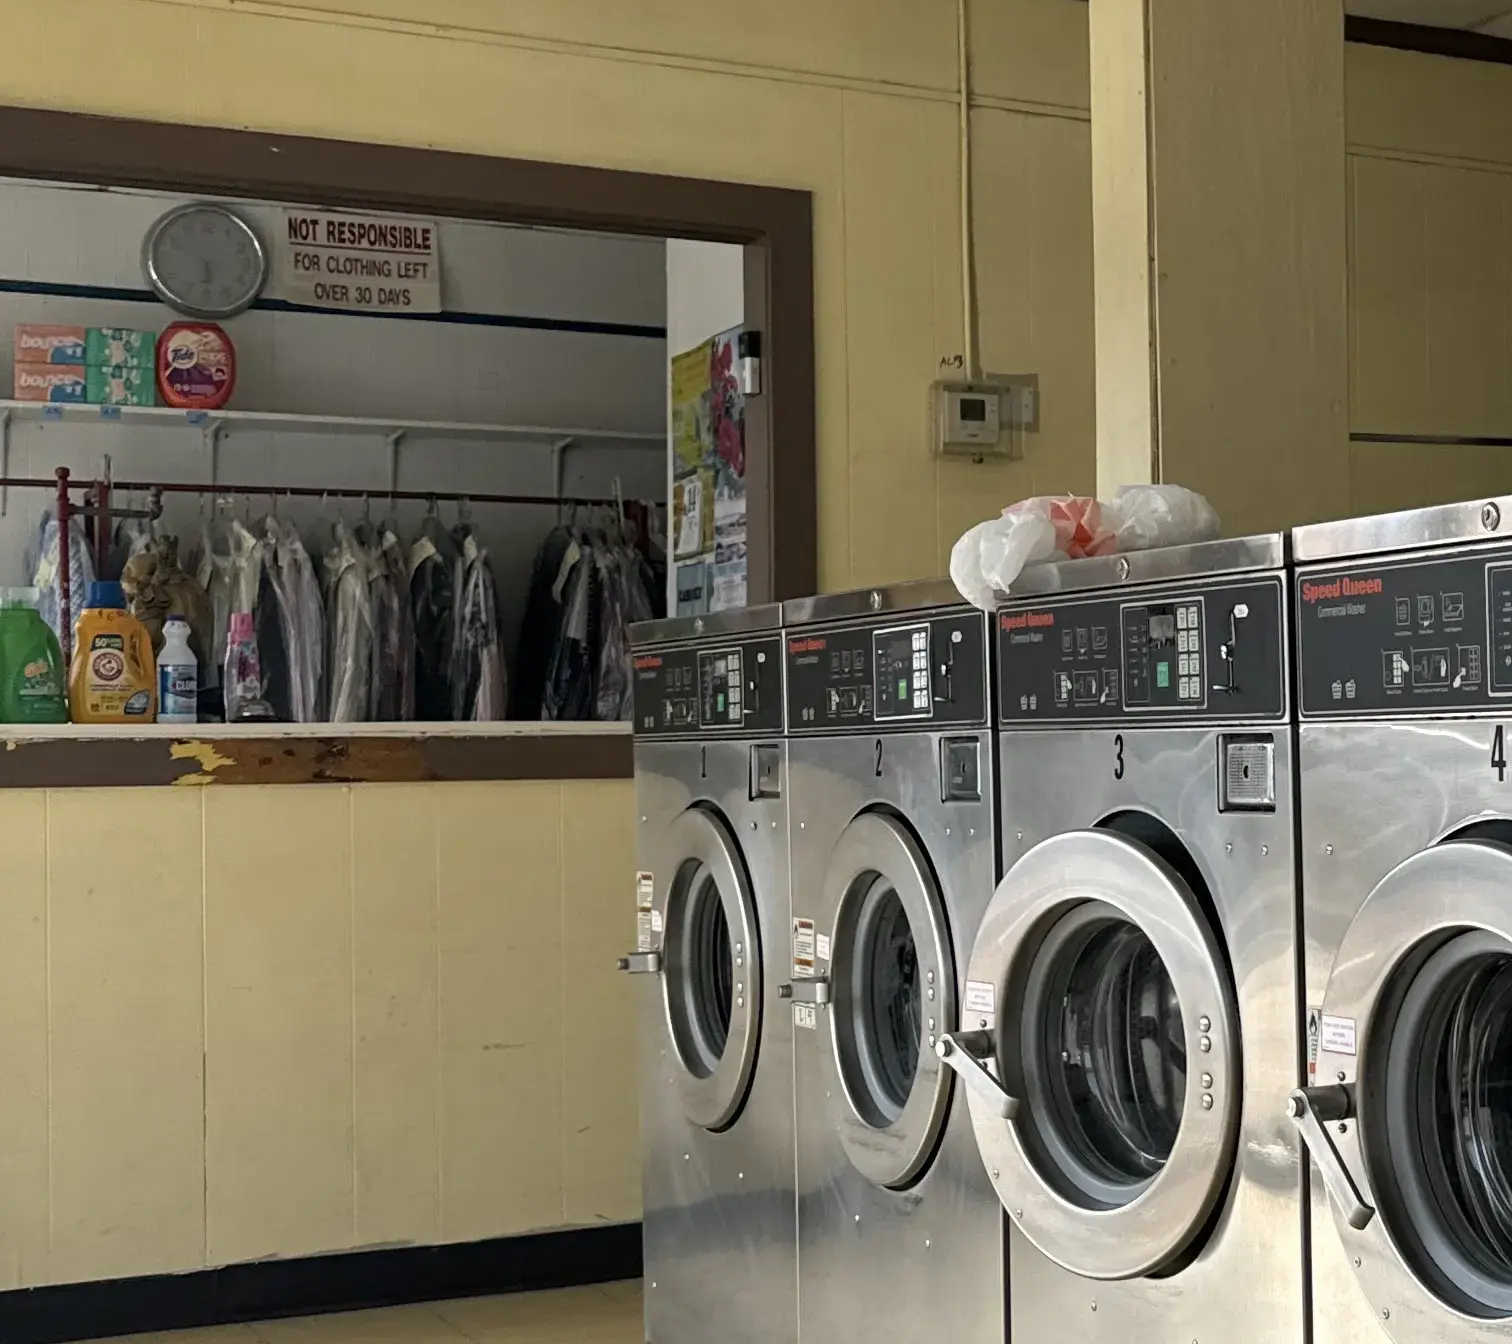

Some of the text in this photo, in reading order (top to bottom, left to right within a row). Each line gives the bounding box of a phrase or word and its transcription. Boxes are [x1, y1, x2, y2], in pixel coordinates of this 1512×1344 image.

[287, 217, 432, 251] NOT RESPONSIBLE
[294, 252, 428, 279] FOR CLOTHING LEFT
[314, 282, 411, 306] OVER 30 DAYS
[171, 348, 195, 363] Tide
[1302, 576, 1382, 603] Speed Queen
[1001, 613, 1027, 632] Speed
[701, 746, 707, 779] 1
[875, 738, 882, 777] 2
[1114, 733, 1124, 780] 3
[1491, 724, 1506, 782] 4
